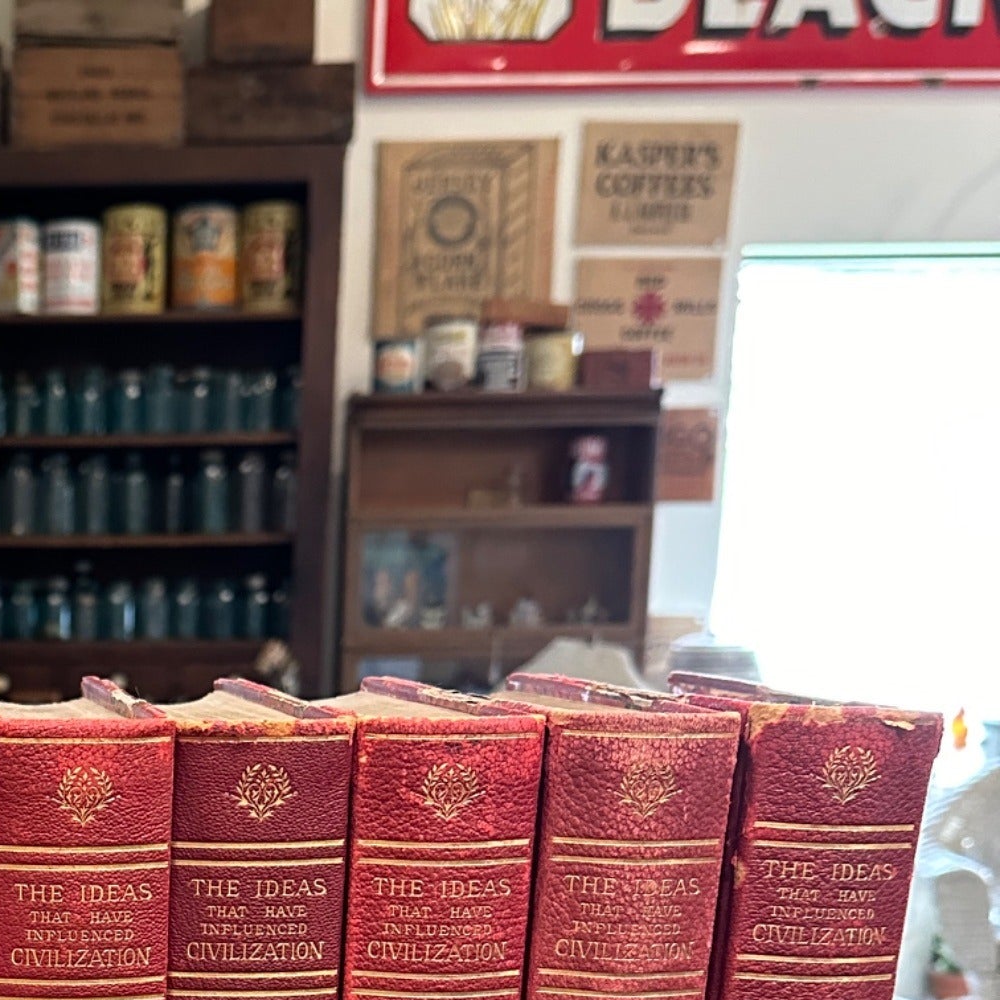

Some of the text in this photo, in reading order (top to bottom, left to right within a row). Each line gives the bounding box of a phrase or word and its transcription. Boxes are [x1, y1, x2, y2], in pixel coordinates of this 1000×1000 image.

[763, 860, 893, 881] THE IDEAS
[14, 883, 153, 902] THE IDEAS
[191, 878, 327, 898] THE IDEAS
[373, 878, 511, 898] THE IDEAS
[563, 875, 701, 896] THE IDEAS
[777, 887, 876, 902] THAT HAVE
[30, 910, 134, 924] THAT HAVE
[206, 905, 308, 918] THAT HAVE
[389, 905, 492, 919] THAT HAVE
[580, 902, 682, 918] THAT HAVE
[771, 905, 875, 920] INFLUENCED
[26, 929, 135, 942] INFLUENCED
[202, 923, 308, 936] INFLUENCED
[383, 923, 492, 937] INFLUENCED
[752, 924, 887, 946] CIVILIZATION
[11, 947, 152, 967] CIVILIZATION
[187, 941, 325, 961] CIVILIZATION
[367, 941, 507, 962] CIVILIZATION
[555, 939, 695, 961] CIVILIZATION
